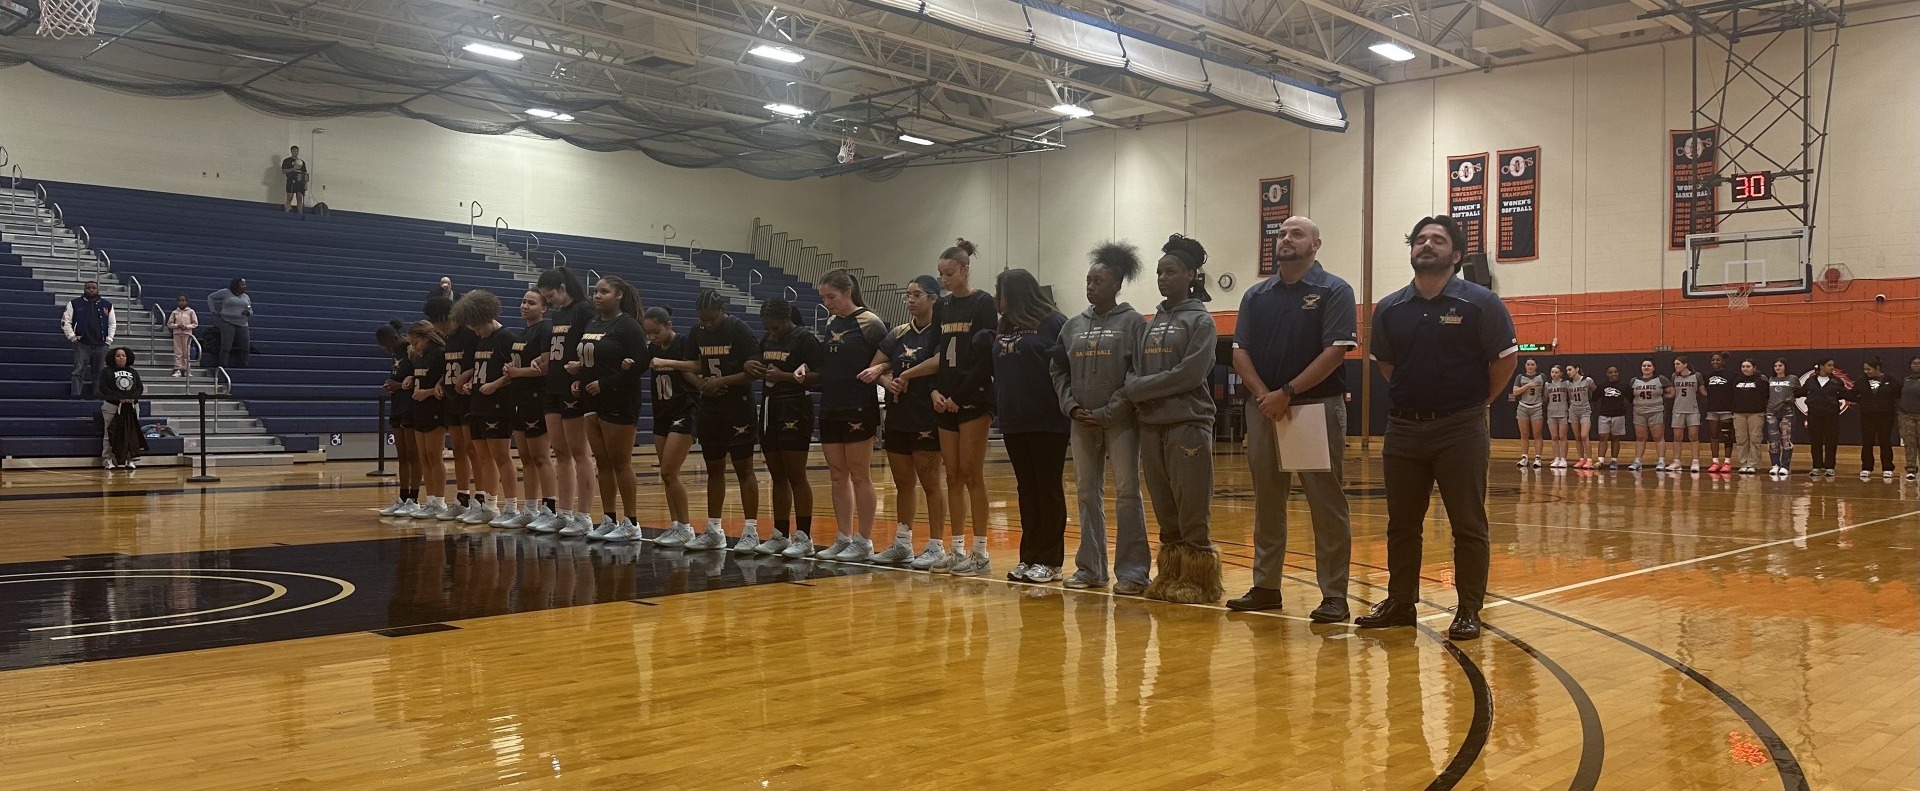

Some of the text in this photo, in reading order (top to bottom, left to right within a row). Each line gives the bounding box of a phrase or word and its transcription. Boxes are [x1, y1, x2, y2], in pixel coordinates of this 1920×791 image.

[1736, 175, 1764, 198] 30
[1453, 203, 1480, 211] WOMEN'S
[1452, 210, 1480, 218] SOFTBALL
[550, 335, 565, 361] 25
[699, 343, 732, 355] VIKINGS
[946, 336, 957, 367] 4
[114, 370, 133, 378] NIKE
[445, 362, 461, 385] 23
[1529, 388, 1536, 396] 3
[1639, 391, 1652, 399] 45
[1681, 388, 1687, 397] 5
[1552, 393, 1561, 402] 21
[1573, 393, 1581, 402] 11
